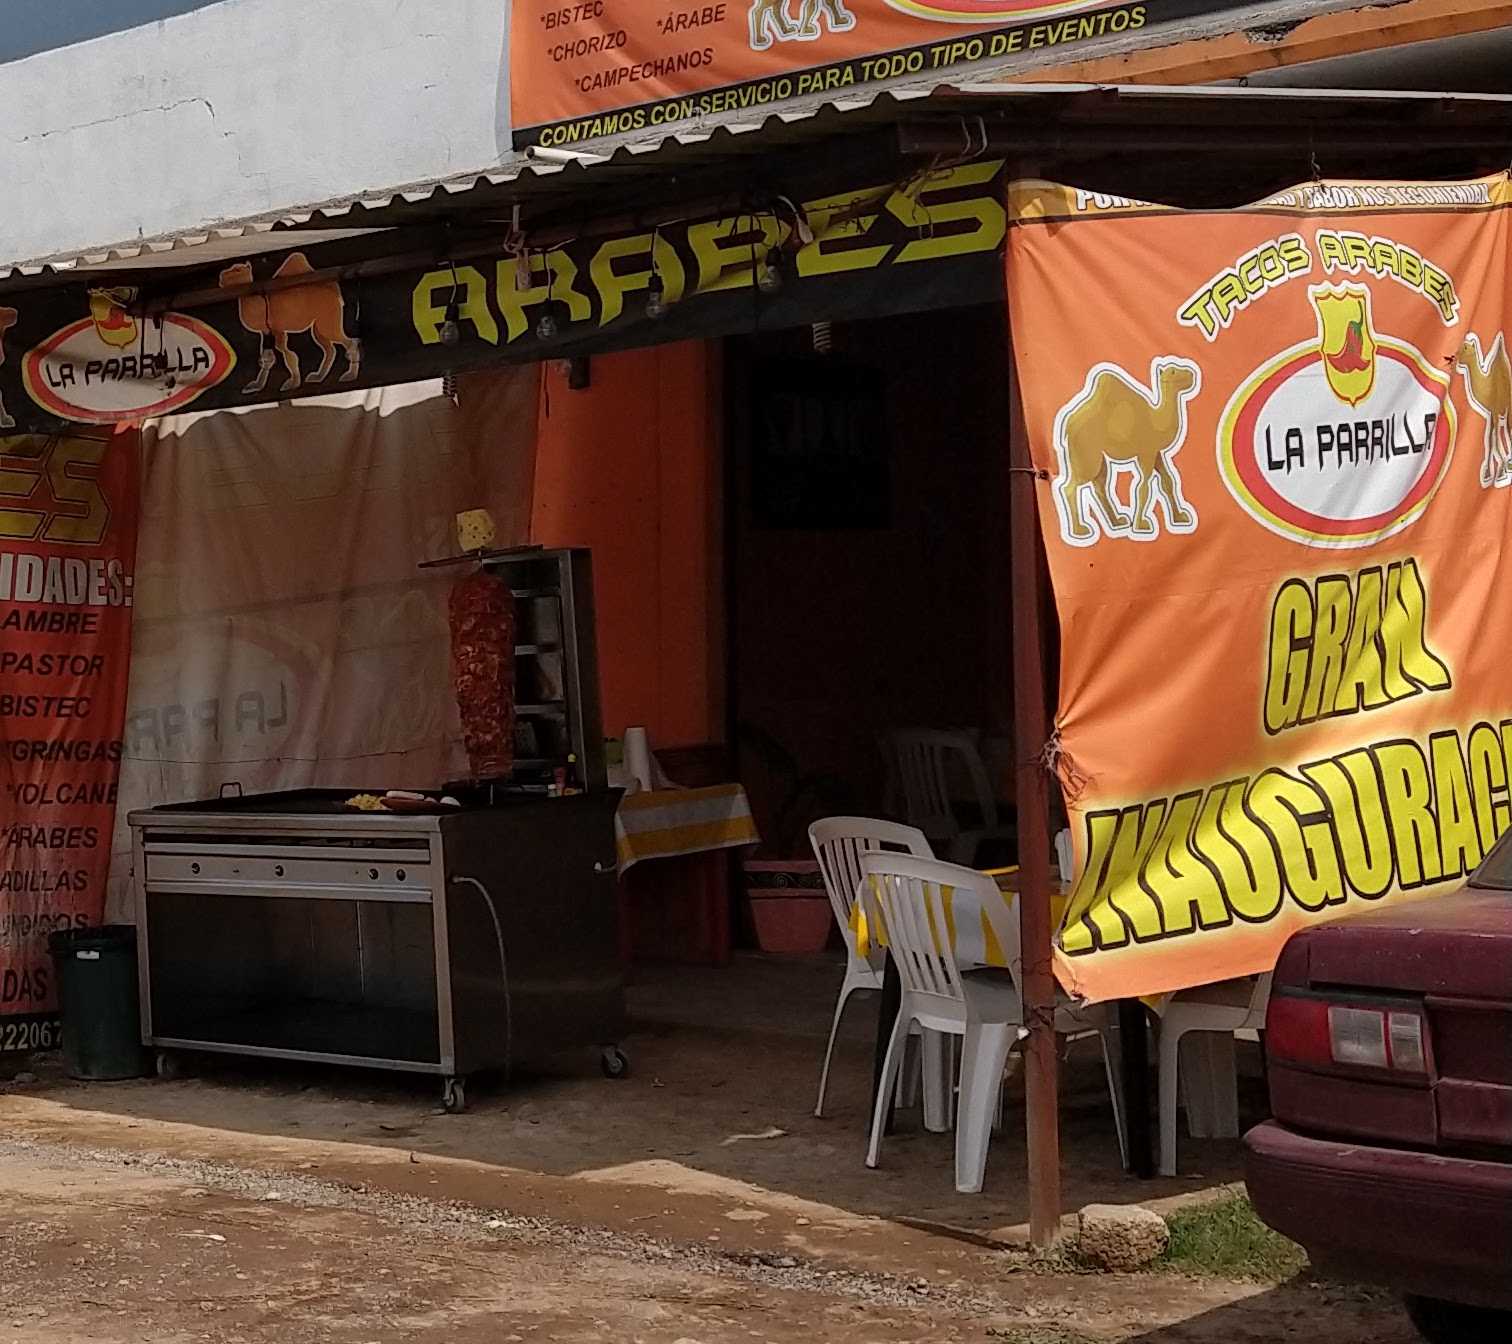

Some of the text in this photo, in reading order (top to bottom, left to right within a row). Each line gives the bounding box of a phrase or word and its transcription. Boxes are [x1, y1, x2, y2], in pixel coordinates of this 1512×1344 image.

[539, 7, 1147, 147] CONTAMOS CON SERVICIO PARA TODO TIPO DE EVENTOS
[1306, 184, 1360, 208] SABOR
[1357, 186, 1395, 207] NOS
[1389, 183, 1492, 206] RECOMIENDAN
[412, 158, 1007, 346] ARABES
[1181, 234, 1457, 337] TACOS ARABES
[45, 346, 210, 388] LA PARRLLA
[1265, 424, 1305, 473] LA
[1264, 558, 1451, 735] GRAN
